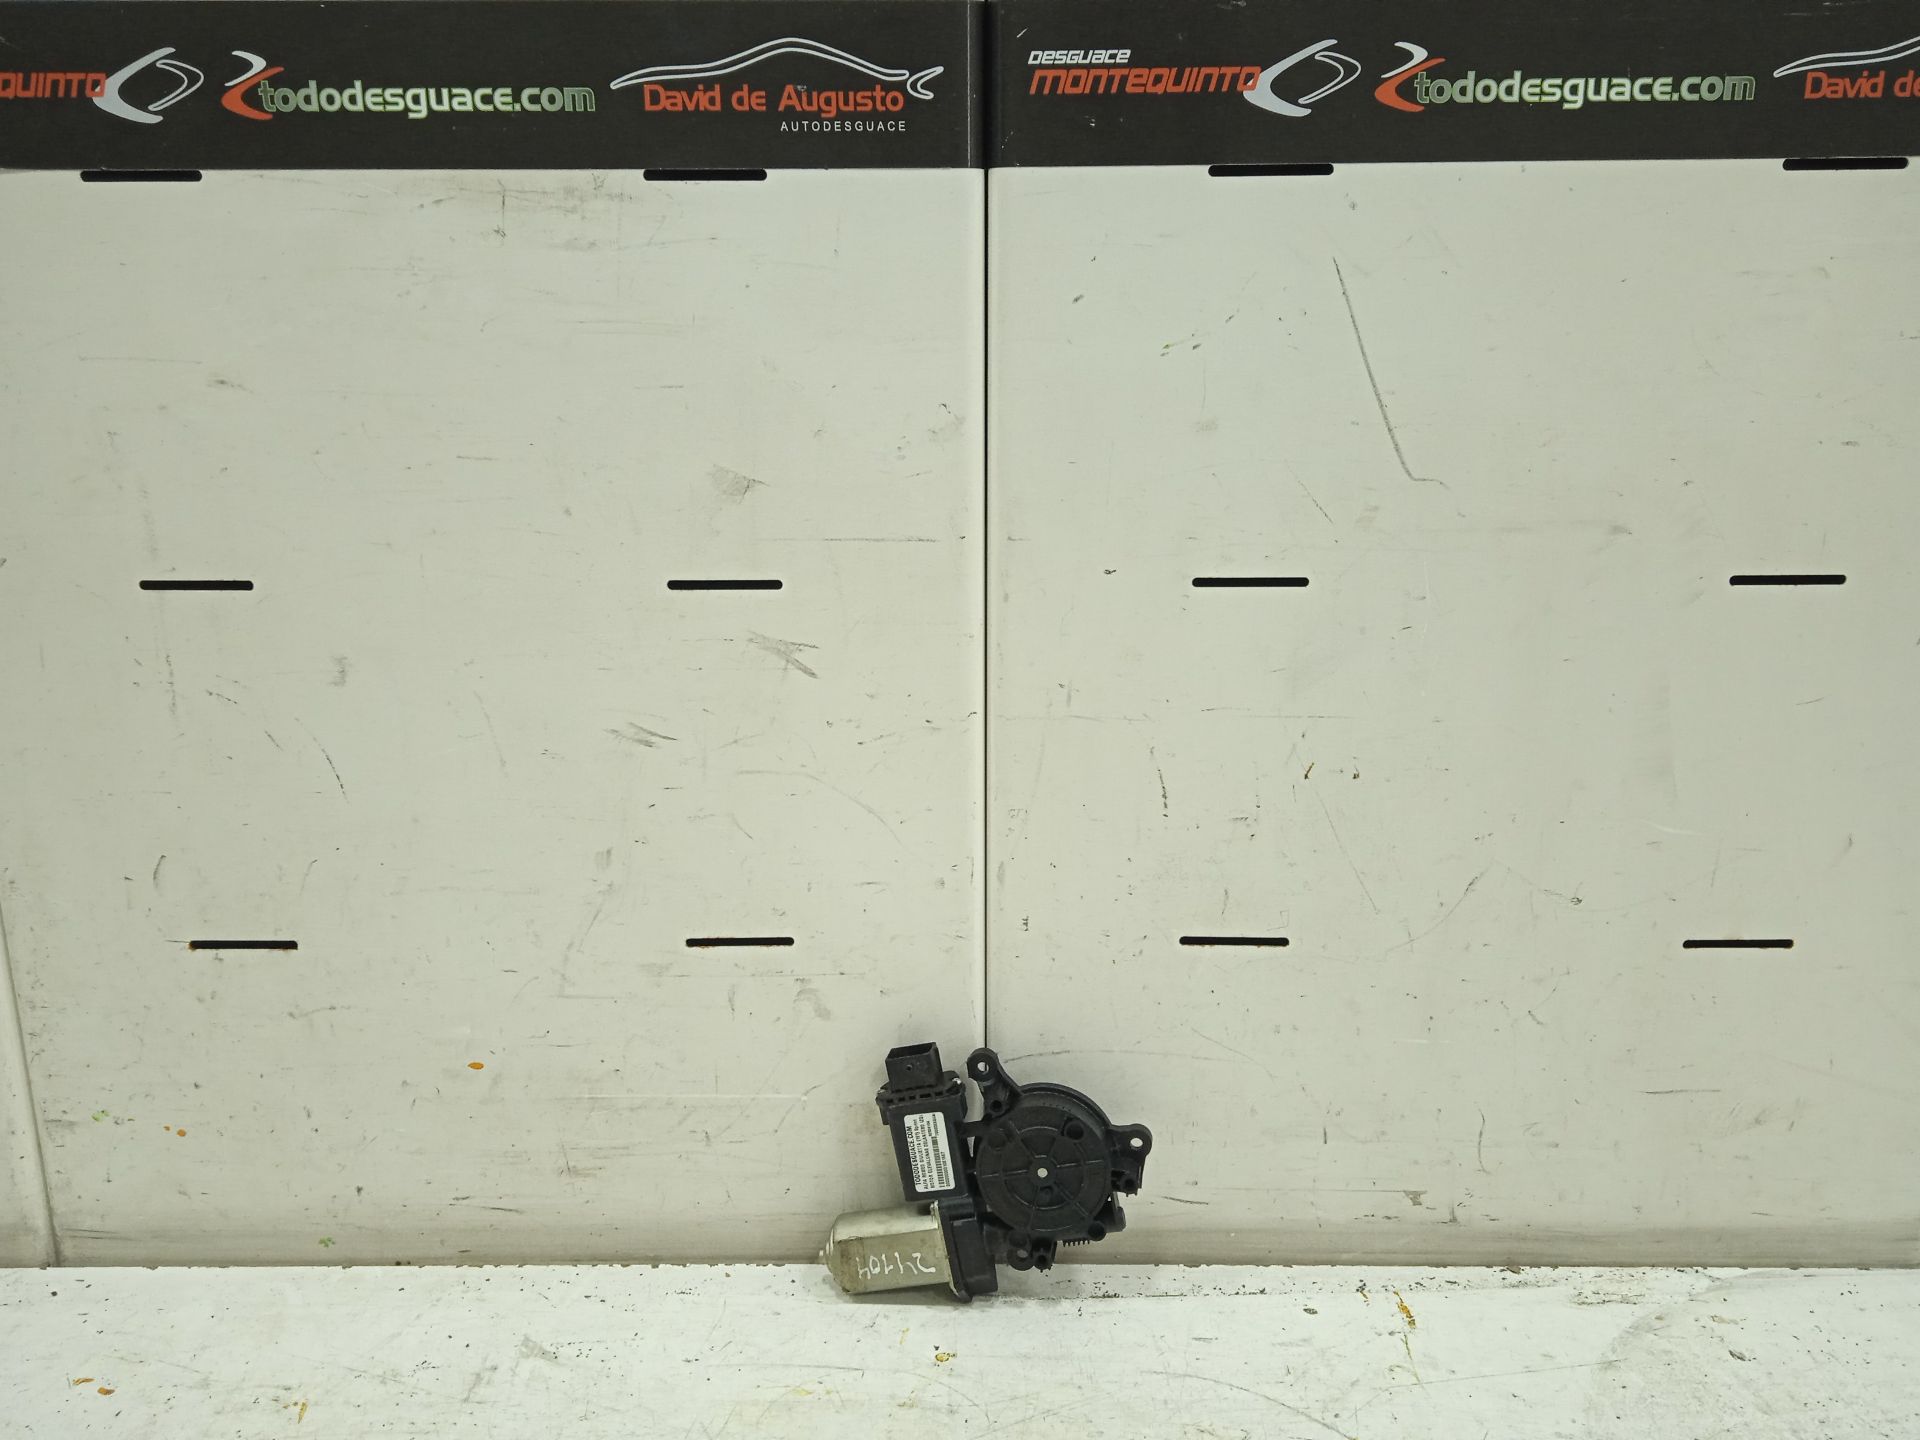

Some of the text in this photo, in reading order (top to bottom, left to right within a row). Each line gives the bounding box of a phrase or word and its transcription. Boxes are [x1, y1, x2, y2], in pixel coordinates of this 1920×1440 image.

[1028, 50, 1131, 65] DESGUACE
[258, 79, 596, 120] tododesguace.com
[1414, 70, 1756, 110] tododesguace.com
[1804, 70, 1886, 99] David
[643, 84, 904, 118] David de Augusto
[780, 120, 906, 132] AUTODESGUACE
